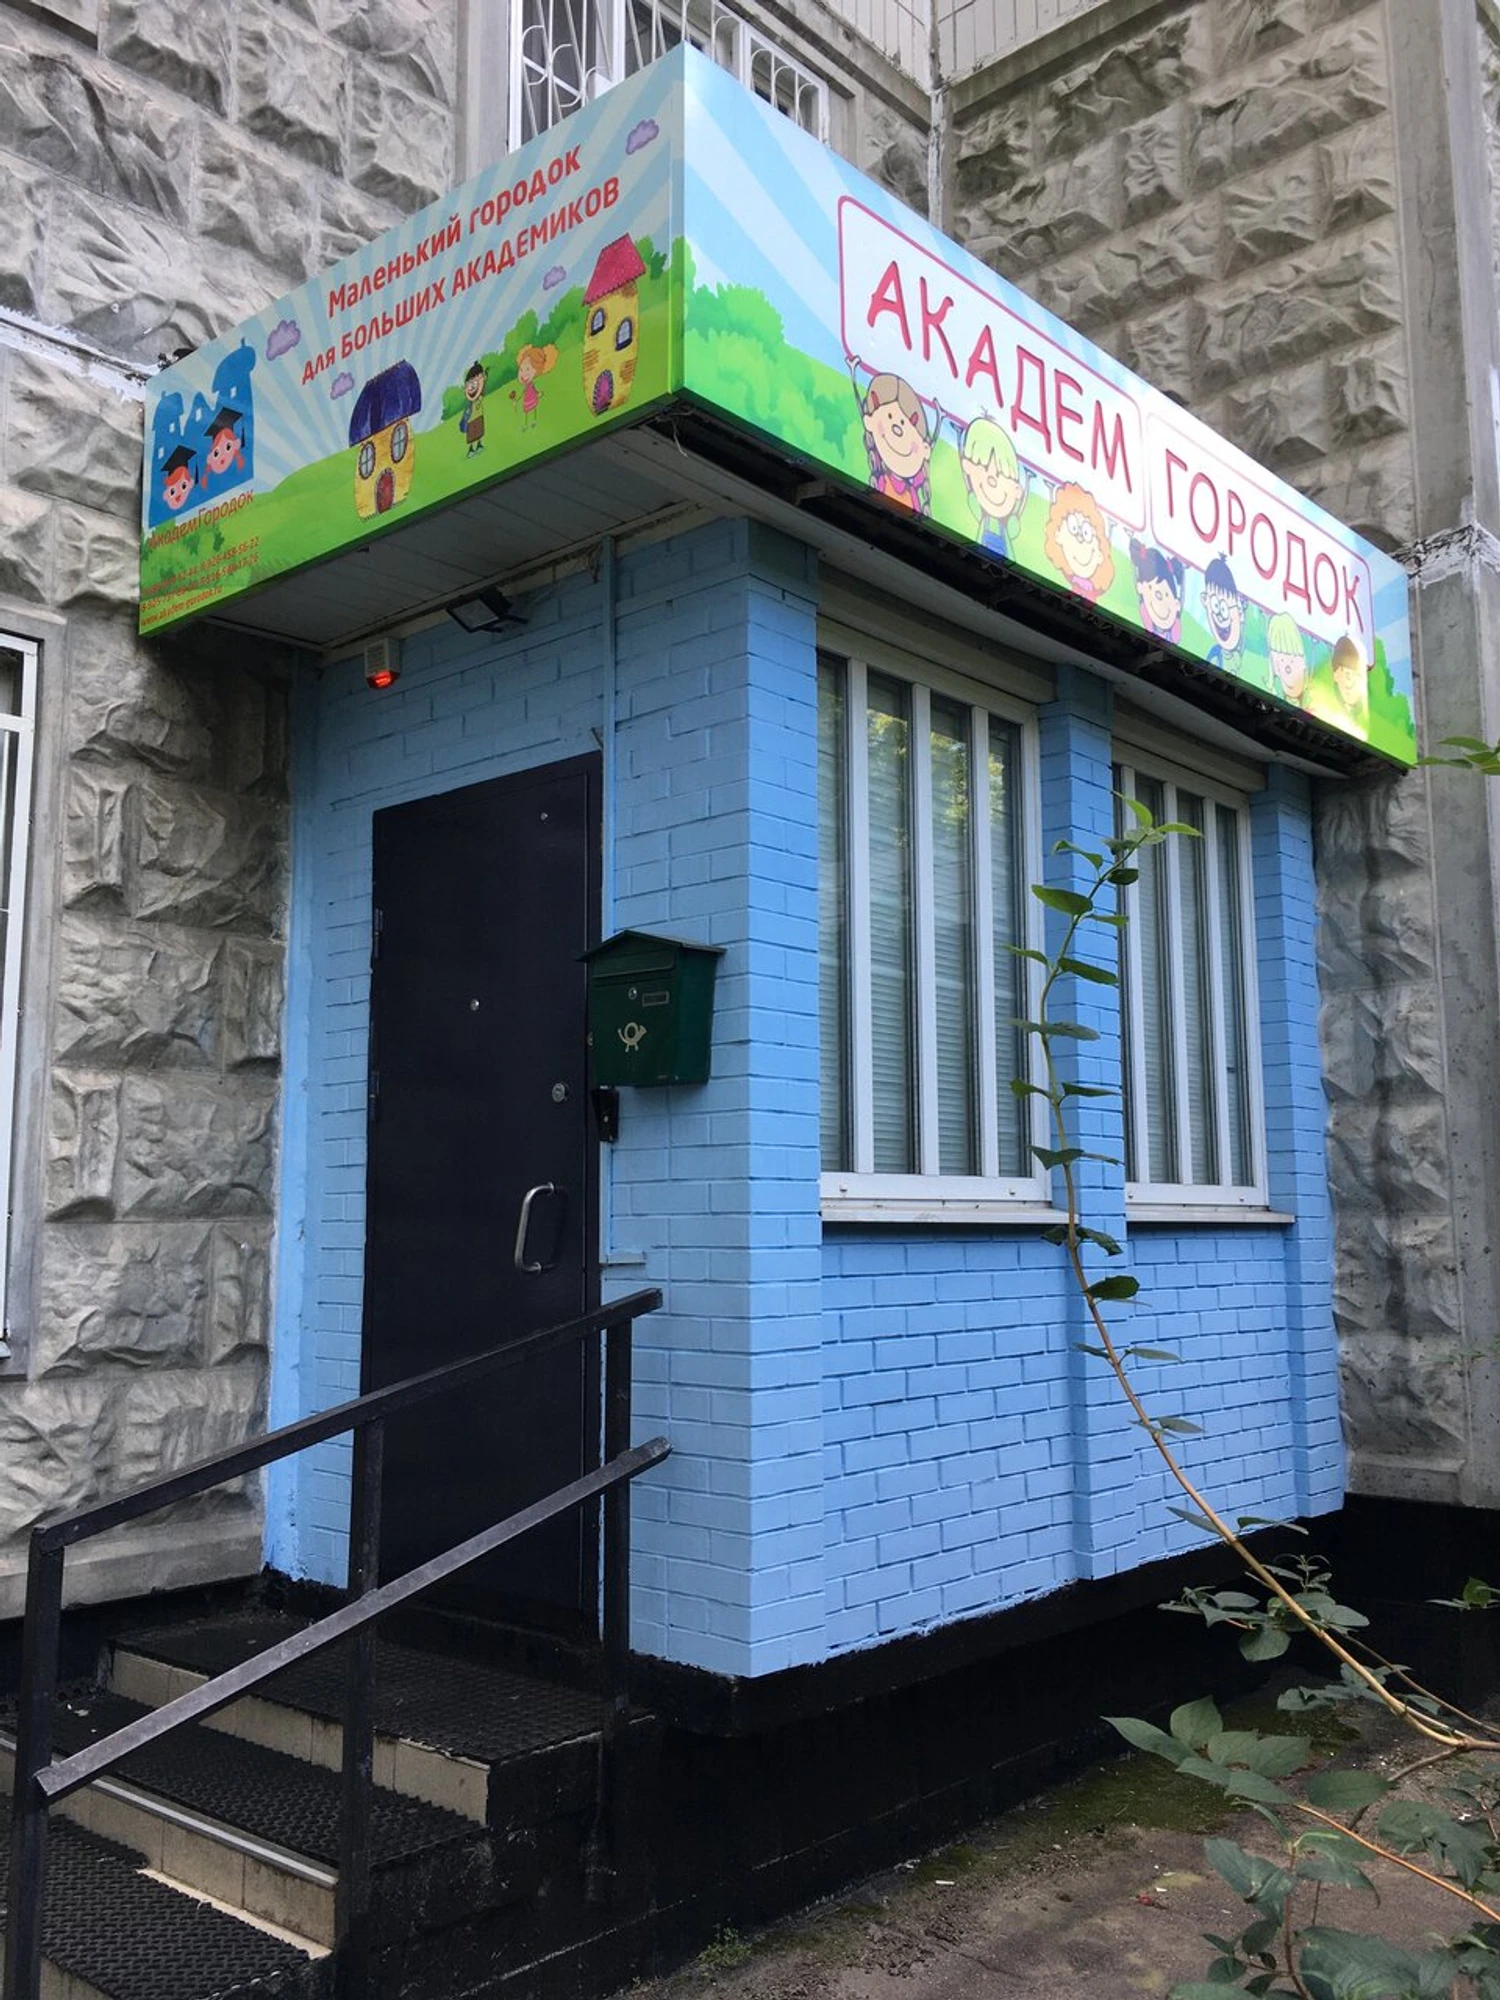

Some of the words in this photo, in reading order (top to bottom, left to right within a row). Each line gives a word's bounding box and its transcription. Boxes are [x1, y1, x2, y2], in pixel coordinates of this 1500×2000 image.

[328, 217, 461, 318] Маленький
[469, 145, 581, 235] городок
[341, 277, 446, 359] БОЛЬШИХ
[452, 176, 619, 297] АКАДЕМИКОВ
[867, 261, 1132, 493] АКАДЕМ
[1166, 449, 1364, 632] ГОРОДОК
